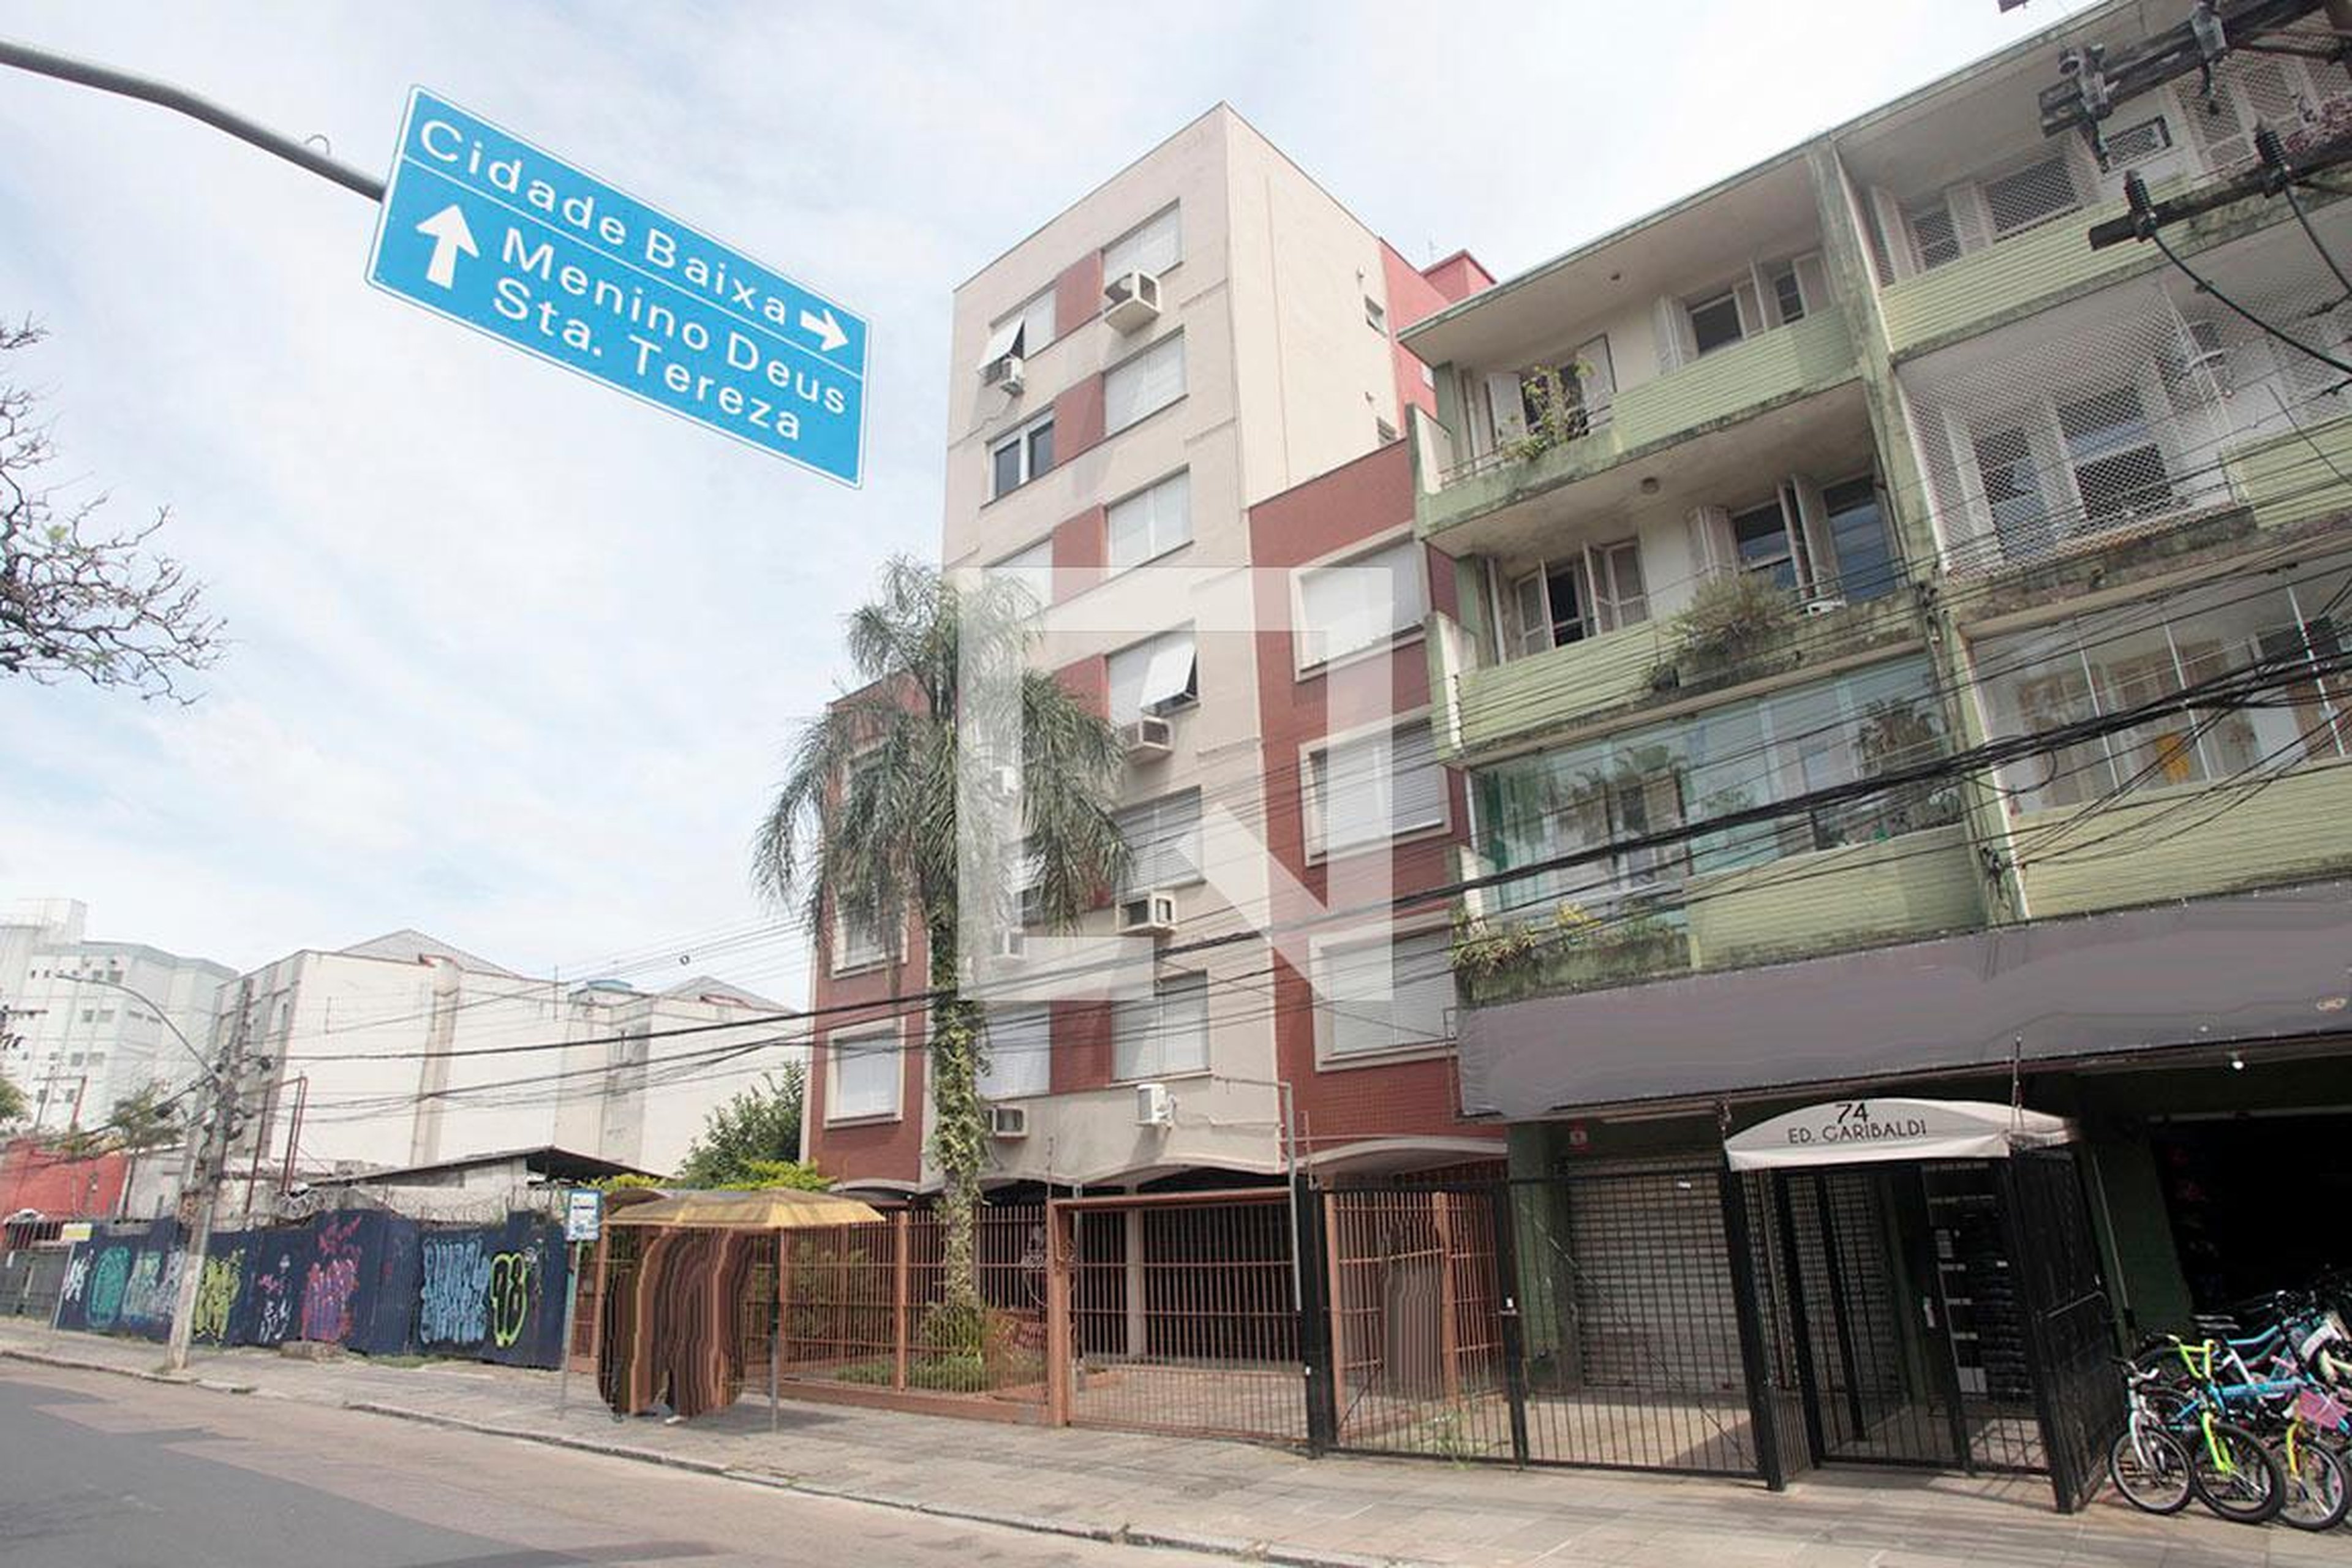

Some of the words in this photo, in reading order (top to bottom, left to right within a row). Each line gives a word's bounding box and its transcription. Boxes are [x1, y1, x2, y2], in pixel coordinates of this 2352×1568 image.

[420, 119, 626, 246] Cidade
[646, 227, 786, 326] Baixa
[493, 277, 602, 357] Sta.
[628, 334, 800, 440] Tereza
[502, 227, 709, 352] Menino
[727, 331, 846, 415] Deus
[1787, 1127, 1817, 1145] ED.
[1835, 1102, 1870, 1125] 74
